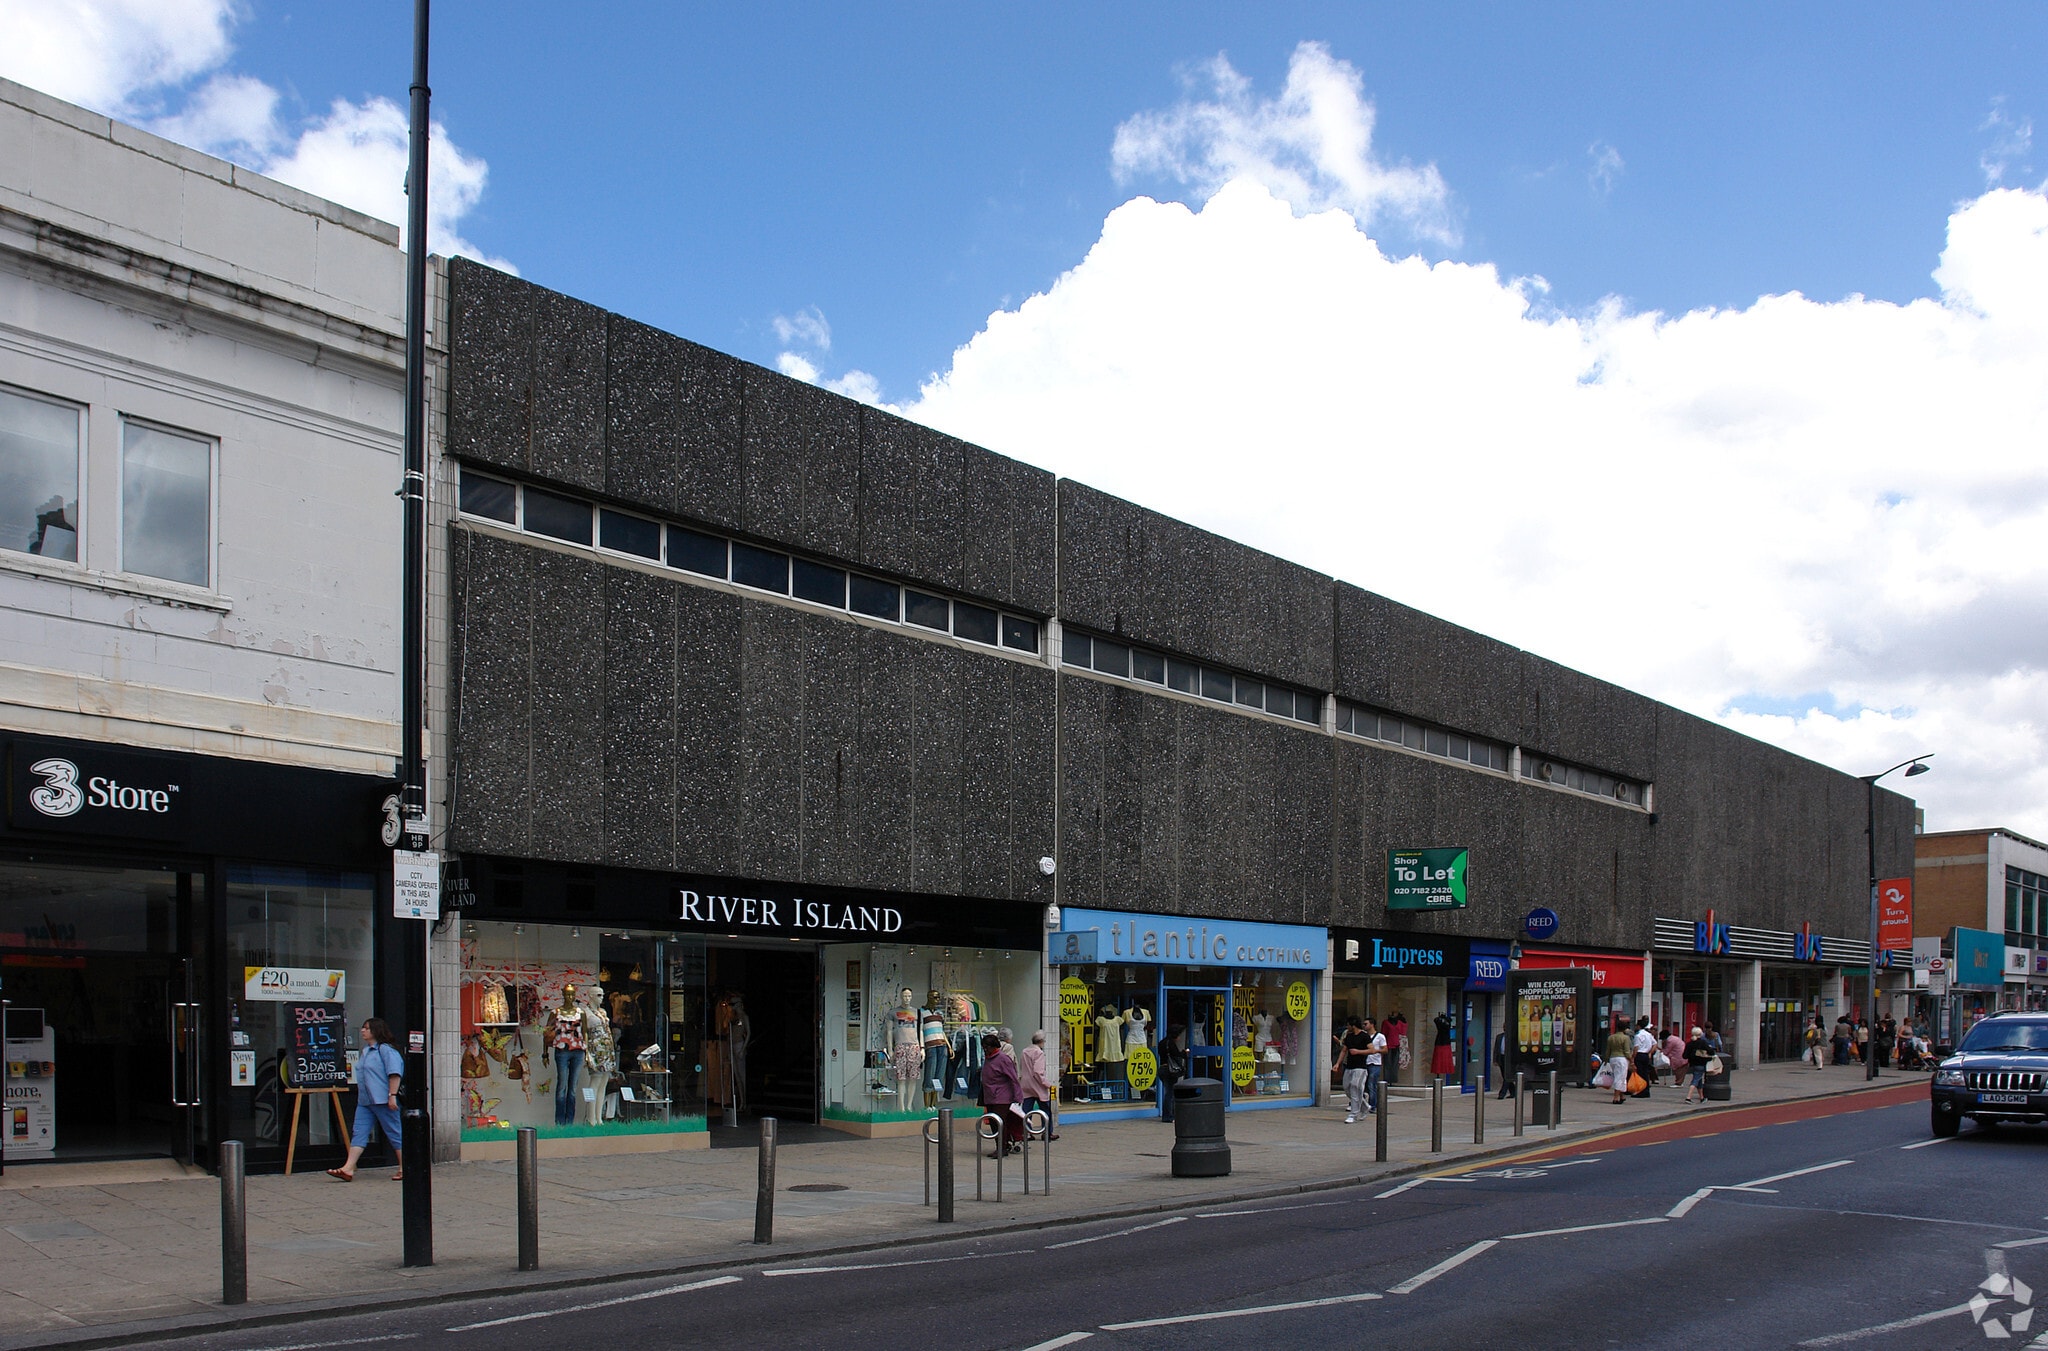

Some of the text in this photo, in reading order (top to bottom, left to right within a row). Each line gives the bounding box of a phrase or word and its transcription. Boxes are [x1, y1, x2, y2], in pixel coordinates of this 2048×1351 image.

[30, 758, 84, 817] 3
[88, 777, 170, 813] Store
[1394, 866, 1455, 881] To Let
[395, 880, 438, 890] CAMERAS OPERATE
[1426, 895, 1452, 903] CBRE
[1886, 908, 1904, 916] Turn
[1529, 917, 1553, 927] REED
[1882, 915, 1909, 926] around
[1066, 934, 1080, 955] a
[1089, 920, 1311, 964] tlantic CLOTHING
[1371, 939, 1443, 968] Impress
[1475, 960, 1502, 978] REED
[261, 970, 289, 987] £20
[1292, 985, 1306, 993] UP TO
[1528, 981, 1541, 989] WIN
[1059, 993, 1087, 1004] DOWN
[1290, 995, 1308, 1007] 75%
[295, 1008, 326, 1021] 500
[1062, 1008, 1081, 1016] SALE
[1292, 1009, 1304, 1017] OFF
[1133, 1052, 1142, 1060] UP
[297, 1057, 336, 1074] 3 DAYS
[1131, 1062, 1153, 1075] 75%
[1231, 1061, 1254, 1071] DOWN
[294, 1071, 347, 1082] LIMITED OFFER
[1235, 1073, 1250, 1081] SALE
[1135, 1078, 1149, 1087] OFF
